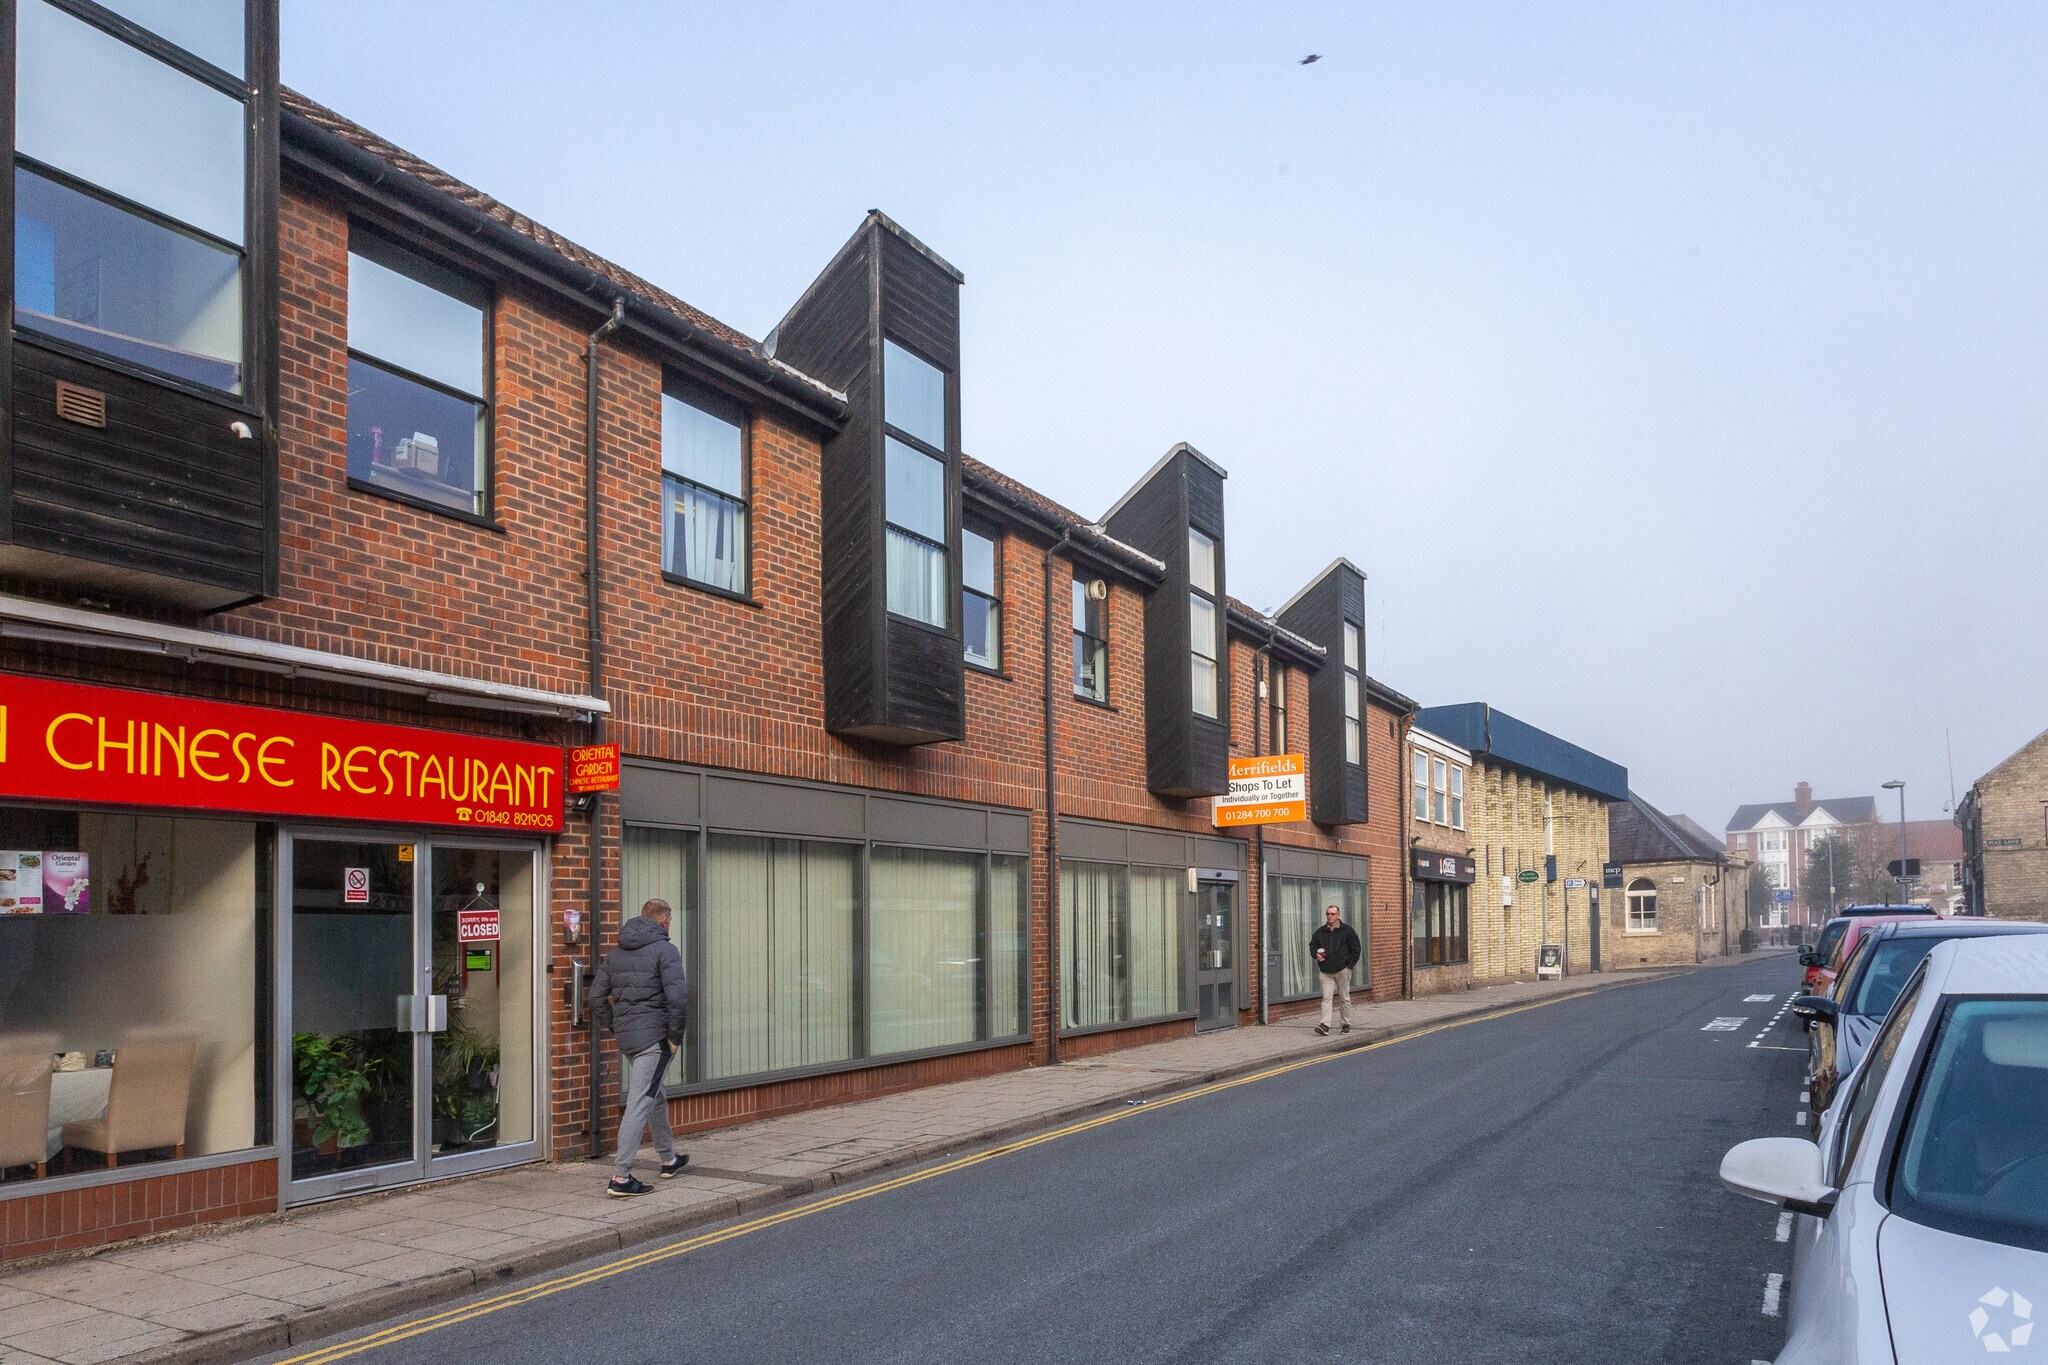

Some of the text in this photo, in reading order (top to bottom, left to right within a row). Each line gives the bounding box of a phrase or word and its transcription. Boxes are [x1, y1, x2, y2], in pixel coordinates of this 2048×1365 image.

[46, 712, 294, 787] CHINESE
[322, 742, 555, 808] RESTAURANT
[572, 746, 616, 762] ORIENTAL
[576, 761, 613, 776] GARDEN
[1229, 778, 1292, 793] Shops To Let
[1222, 794, 1260, 804] Individually
[1270, 791, 1299, 801] Together
[475, 809, 553, 827] 01842 821905
[1225, 807, 1290, 820] 01284 700 700
[1605, 867, 1621, 876] mcp
[461, 923, 499, 937] CLOSED
